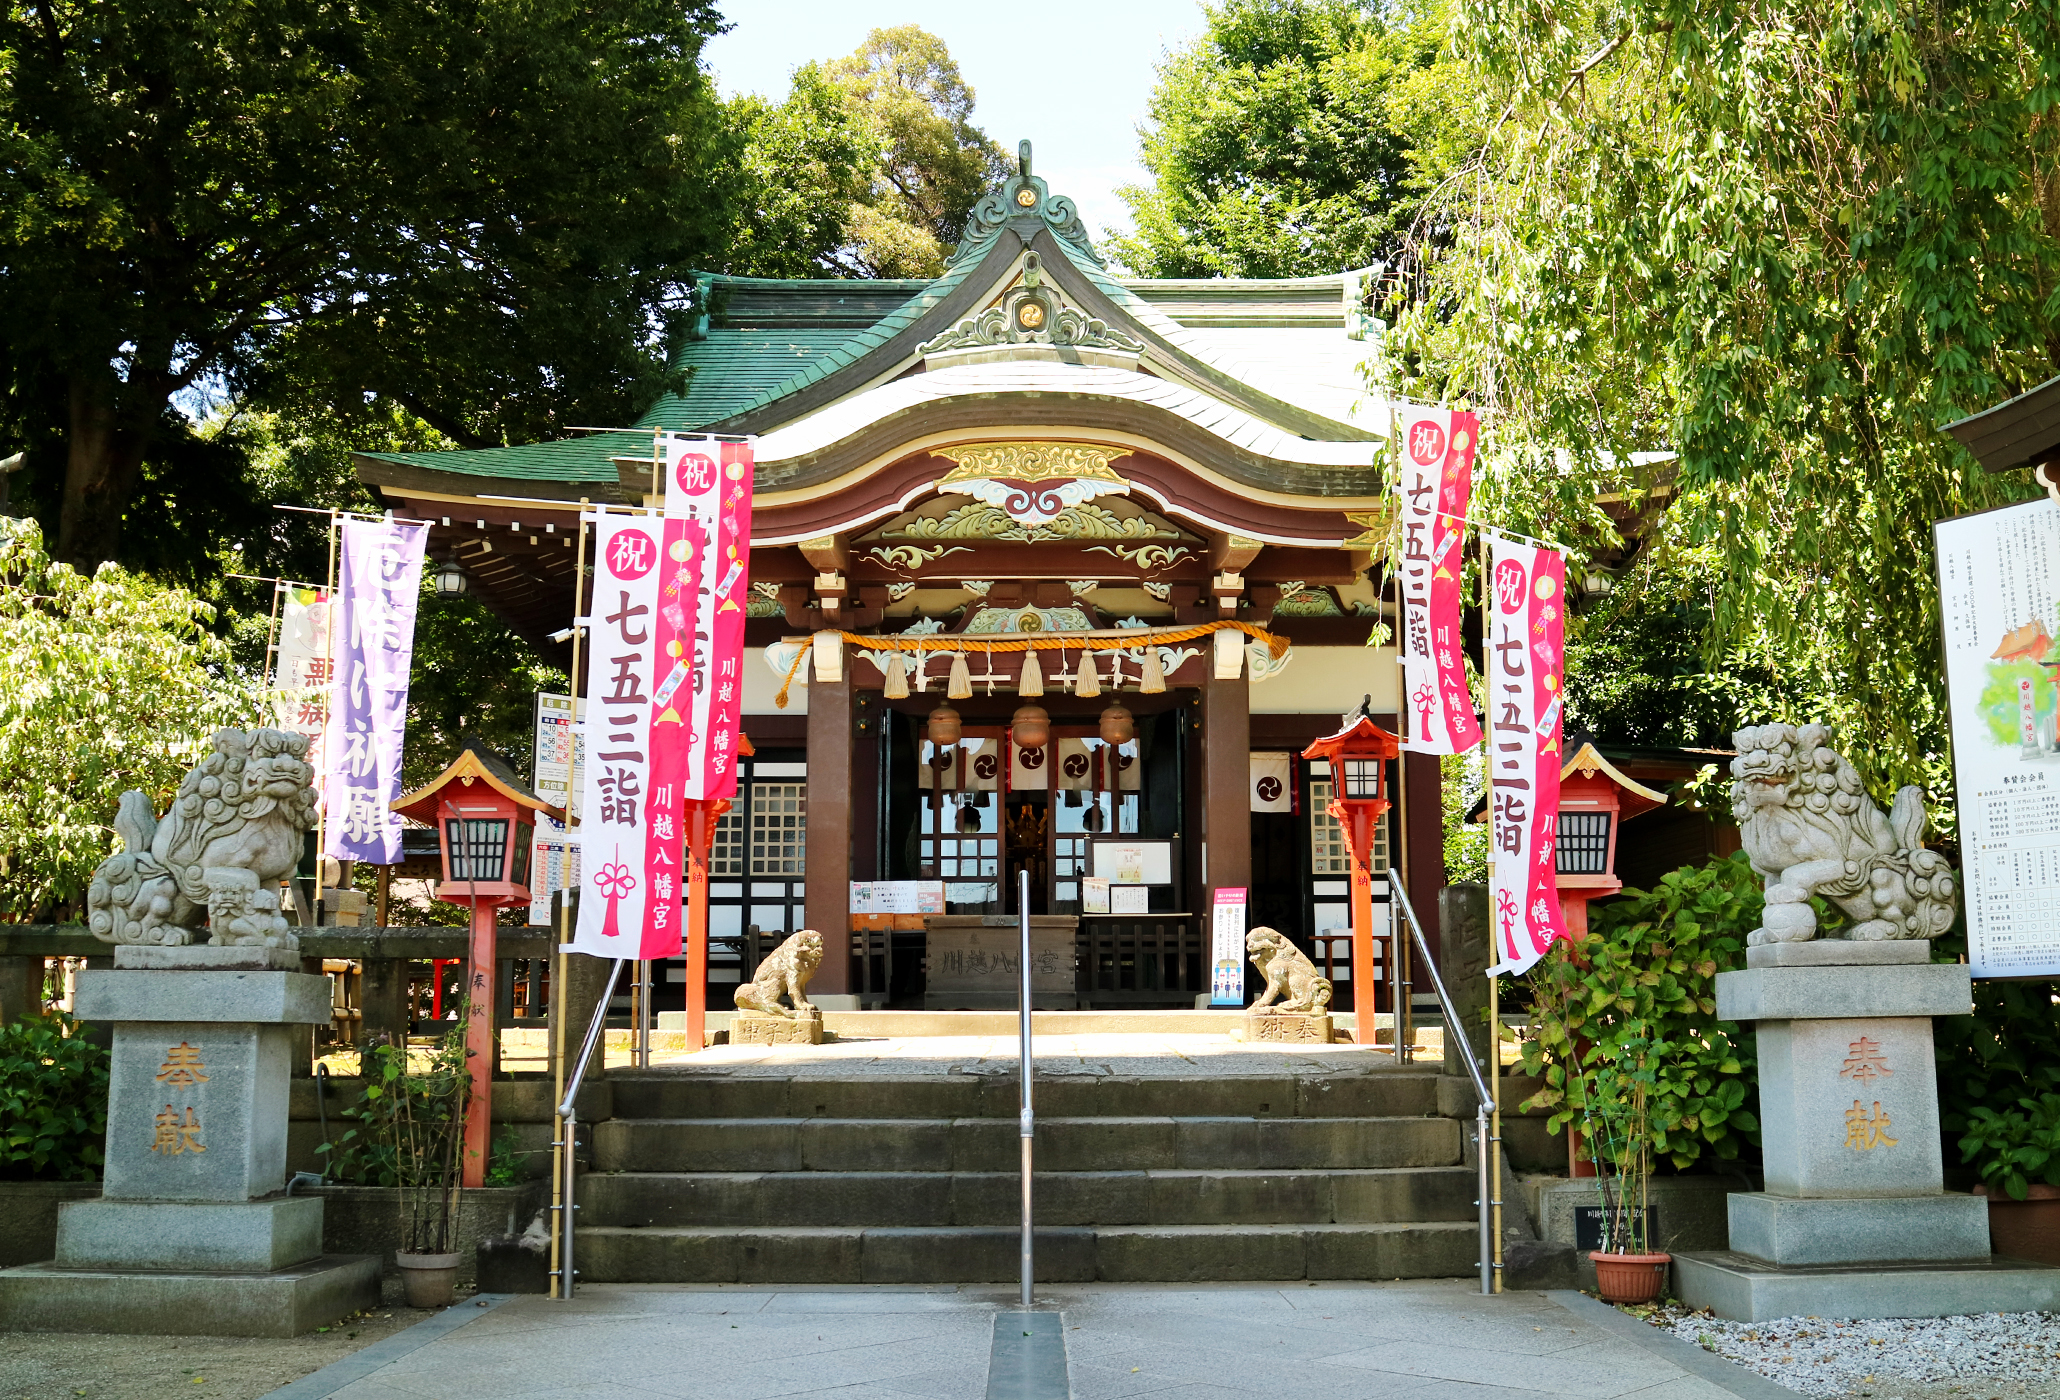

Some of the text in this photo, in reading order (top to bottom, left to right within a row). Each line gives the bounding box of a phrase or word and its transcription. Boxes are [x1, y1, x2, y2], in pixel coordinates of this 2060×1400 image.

[682, 459, 713, 490] 祝
[1413, 427, 1438, 459] 祝
[612, 537, 648, 572] 祝
[1405, 473, 1434, 658] 七五三詣
[1499, 566, 1523, 608] 祝
[337, 534, 410, 847] 厄除け祈願
[597, 590, 650, 829] 七五三詣
[712, 657, 736, 774] 川越八幡宮
[1436, 626, 1467, 734] 川越八幡宮
[2023, 693, 2034, 741] 川越八幡宮
[543, 781, 565, 790] 方位除
[1493, 624, 1530, 857] 七五三詣
[2003, 771, 2045, 785] 奉賛会会員
[650, 783, 676, 930] 川越八幡宮
[1358, 860, 1368, 886] 奉納
[1530, 814, 1556, 948] 川越八幡宮
[472, 973, 486, 1017] 奉献
[151, 1041, 210, 1155] 奉献
[1839, 1036, 1899, 1151] 奉献
